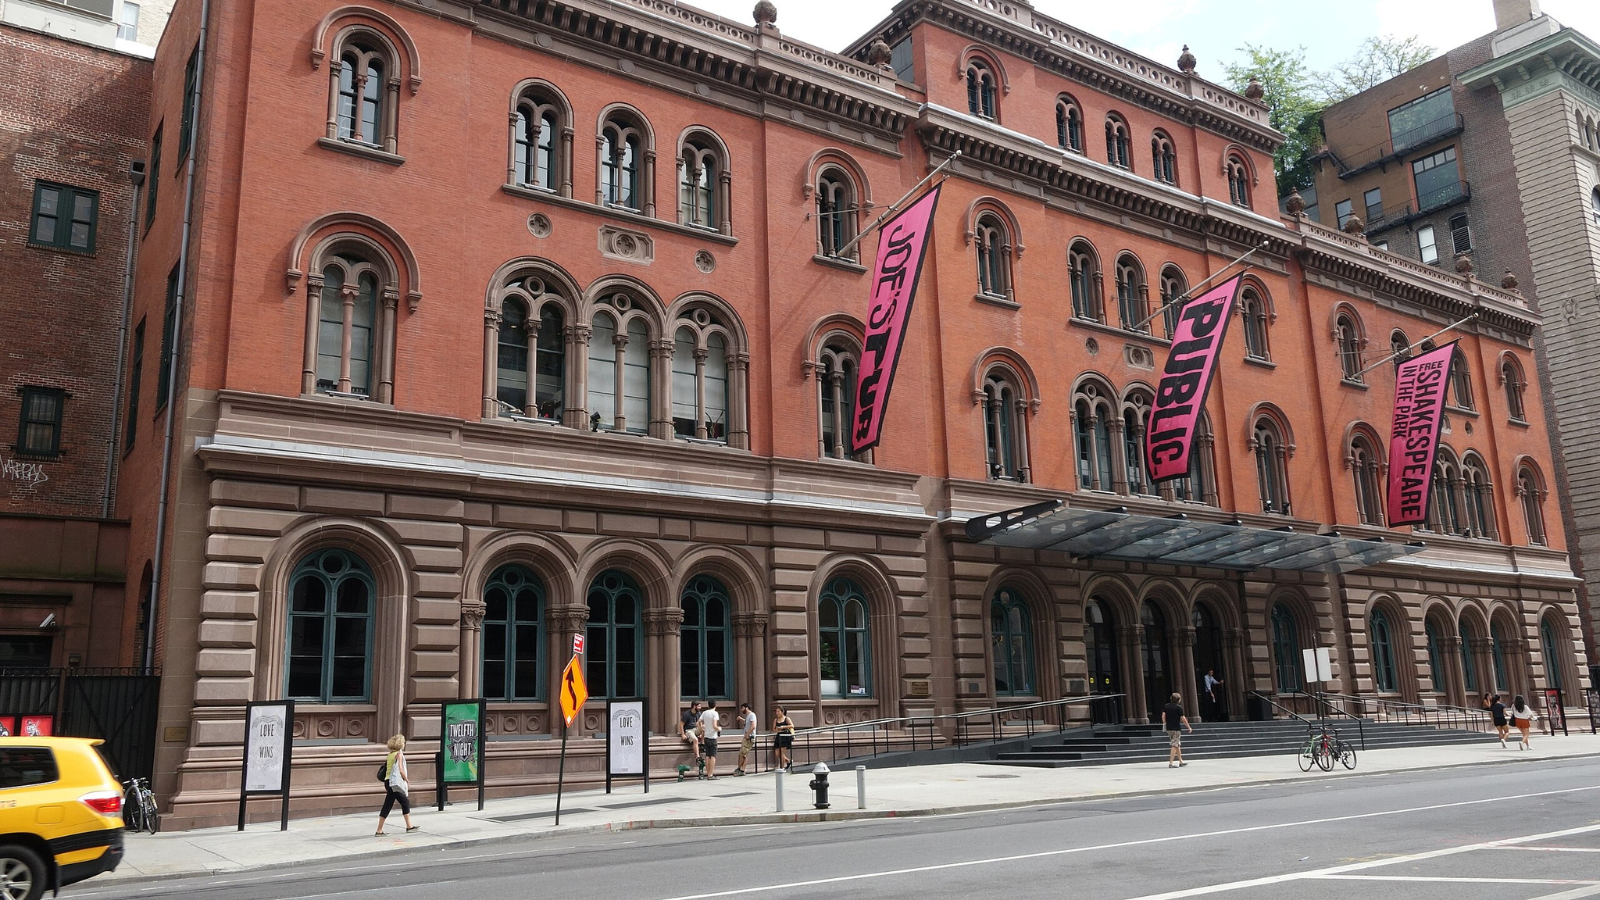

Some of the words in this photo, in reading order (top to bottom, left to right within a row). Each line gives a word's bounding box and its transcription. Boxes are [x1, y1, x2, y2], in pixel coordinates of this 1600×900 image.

[868, 224, 916, 329] JOE'S
[1401, 365, 1418, 378] IN
[1419, 360, 1444, 371] FREE
[1397, 378, 1415, 403] THE
[1393, 405, 1411, 439] PARK
[1401, 369, 1441, 518] SHAKESPEARE
[620, 716, 633, 728] LOVE
[260, 724, 274, 737] LOVE
[450, 723, 474, 737] TWELFTH
[621, 735, 633, 746] WINS
[259, 746, 273, 758] WINS
[454, 743, 471, 756] NIGHT
